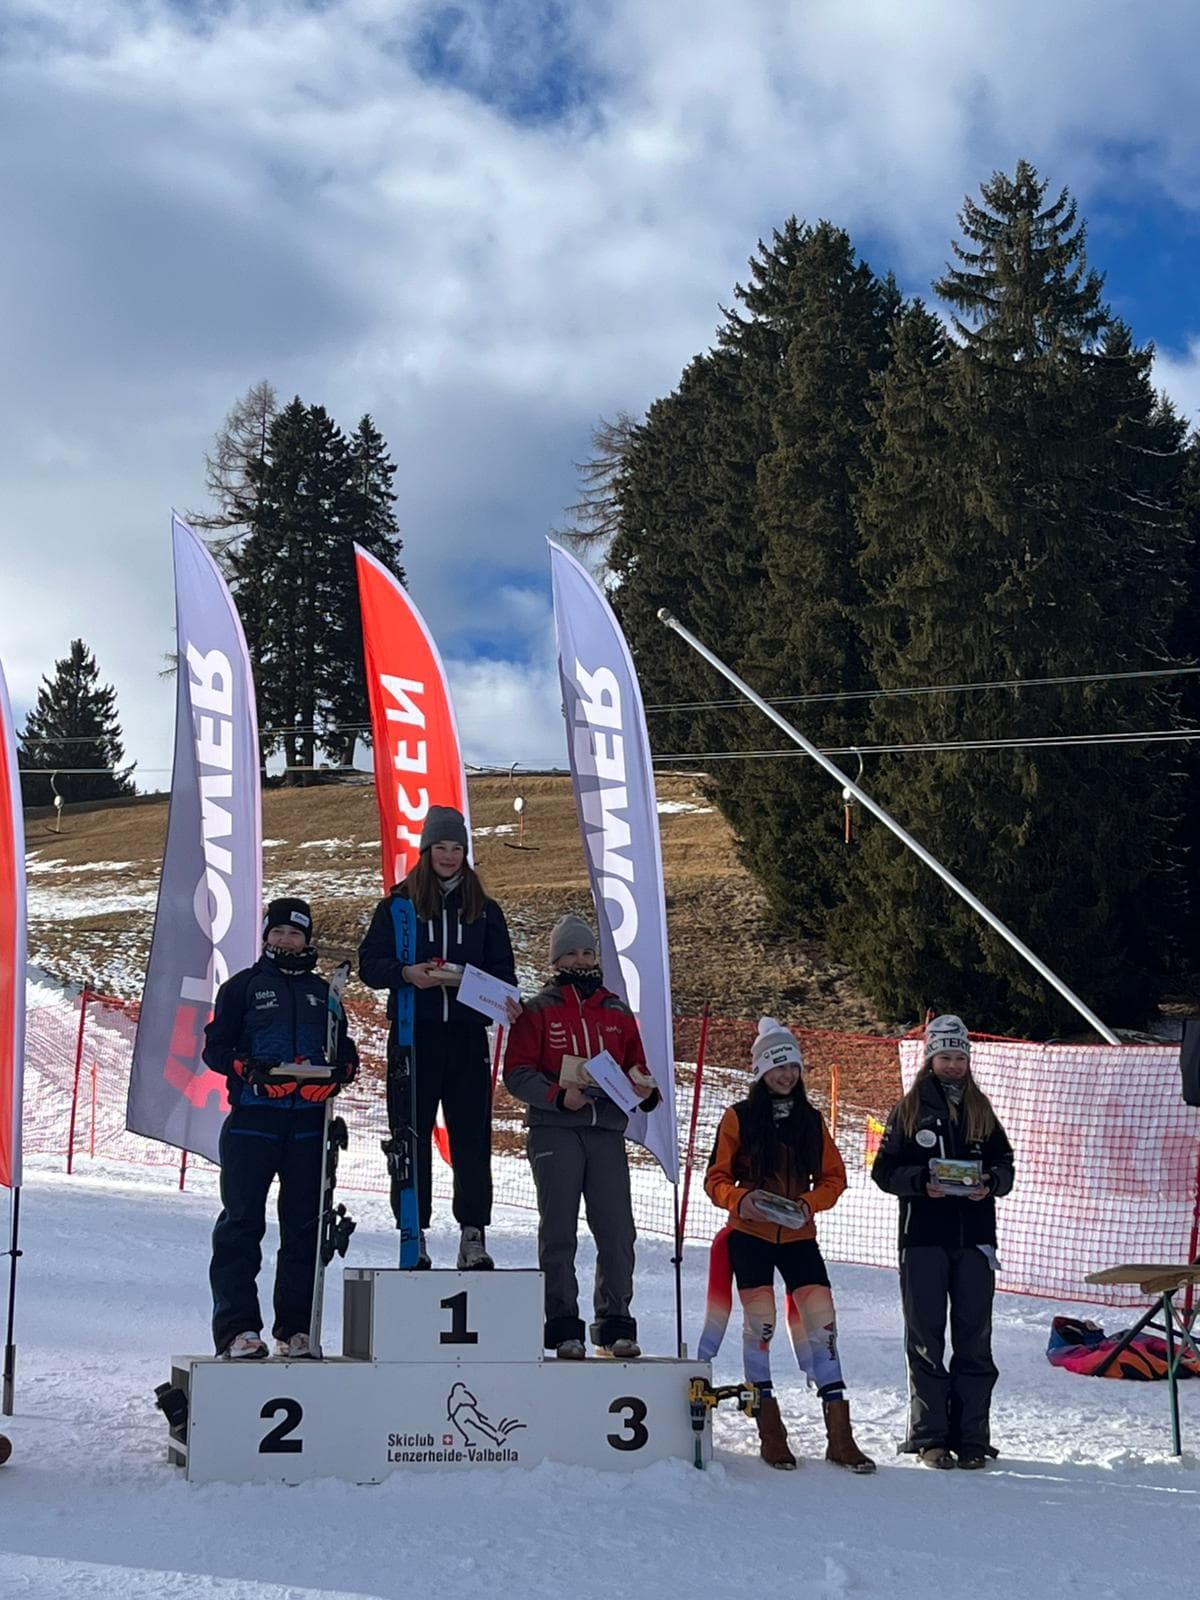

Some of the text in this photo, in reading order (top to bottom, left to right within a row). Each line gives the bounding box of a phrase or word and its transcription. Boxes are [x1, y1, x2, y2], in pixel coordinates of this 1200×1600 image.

[440, 1291, 478, 1344] 1
[258, 1397, 303, 1453] 2
[387, 1433, 434, 1447] Skiclub
[607, 1396, 648, 1451] 3
[387, 1449, 519, 1463] Lenzerheide-Valbella
